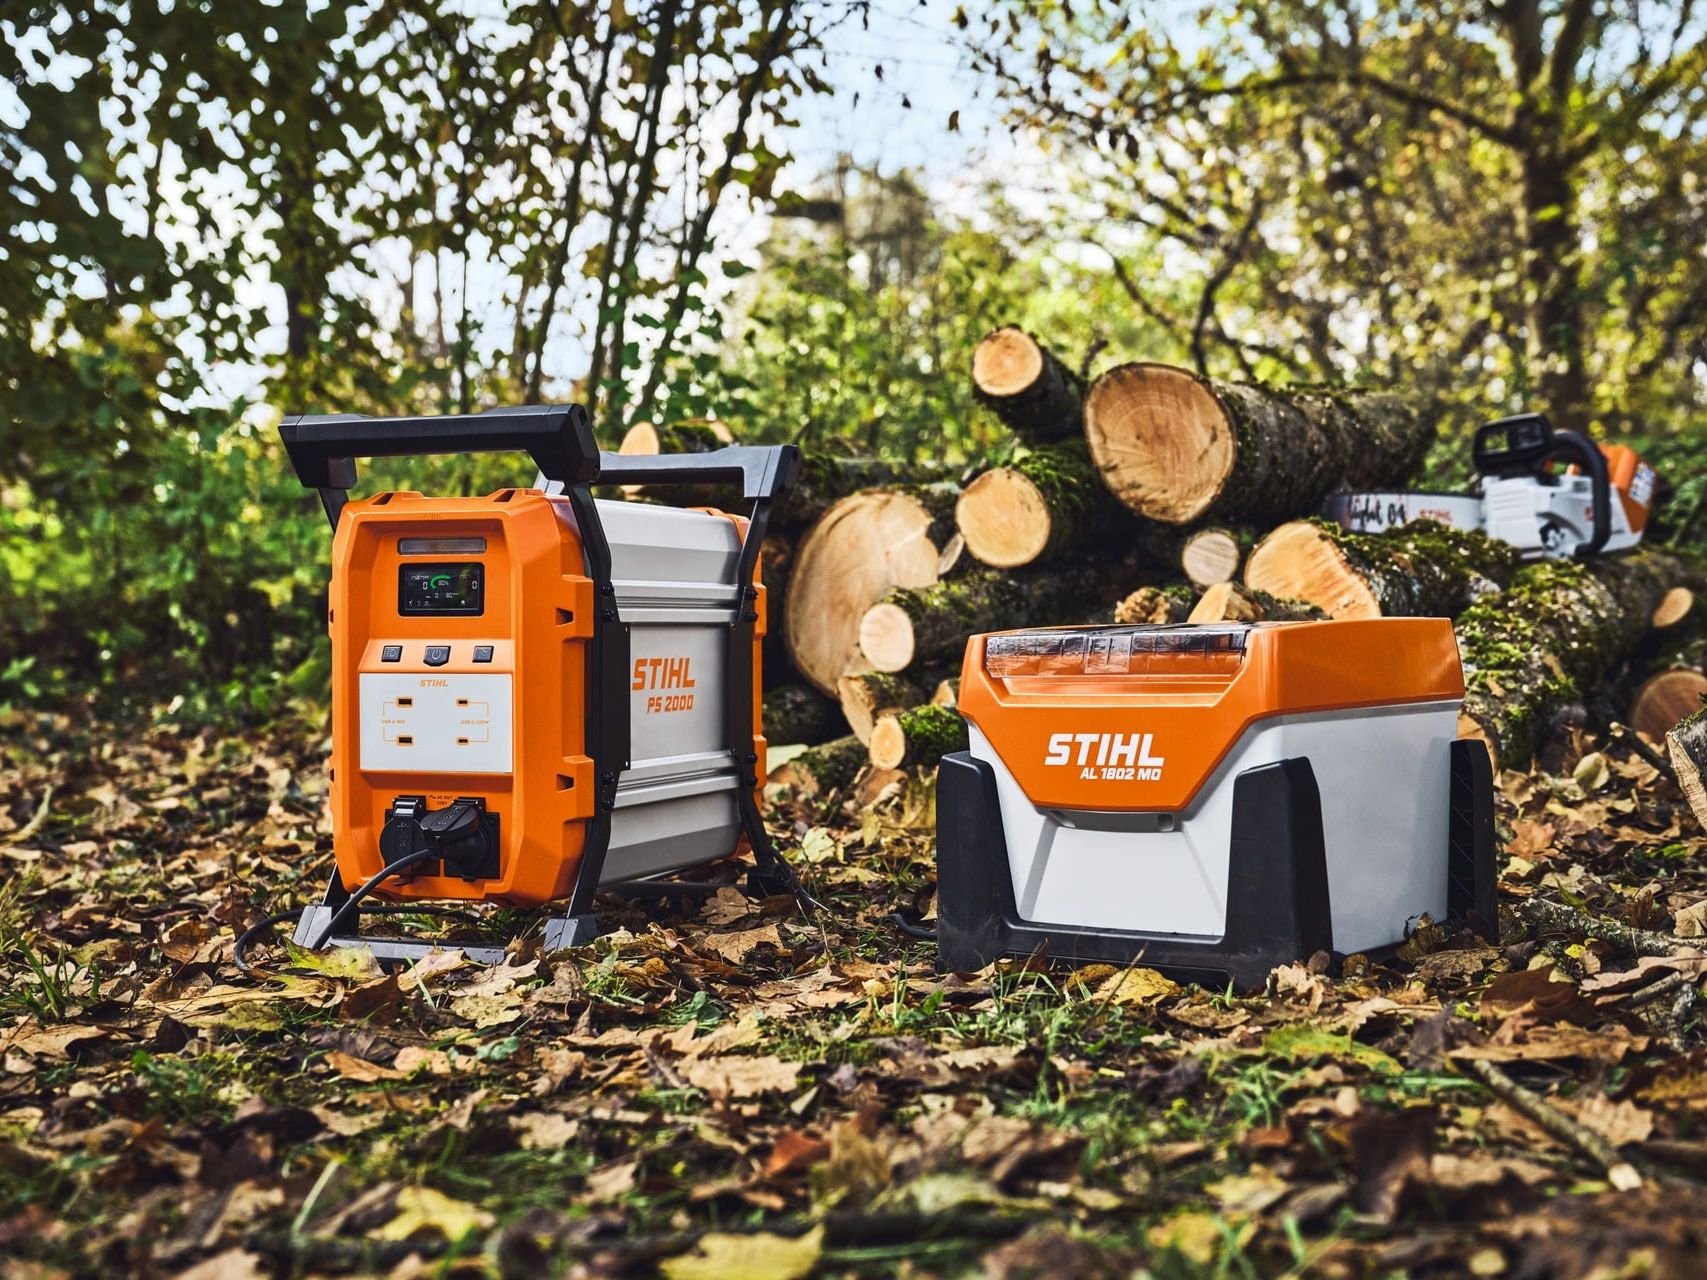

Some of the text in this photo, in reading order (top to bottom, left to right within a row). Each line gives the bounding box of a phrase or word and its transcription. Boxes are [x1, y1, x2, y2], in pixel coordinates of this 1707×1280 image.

[419, 679, 449, 687] STIHL
[632, 657, 696, 690] STIHL
[647, 694, 694, 713] PS 2000
[1044, 733, 1165, 766] STIHL
[1080, 767, 1098, 780] AL
[1101, 767, 1135, 780] 1802
